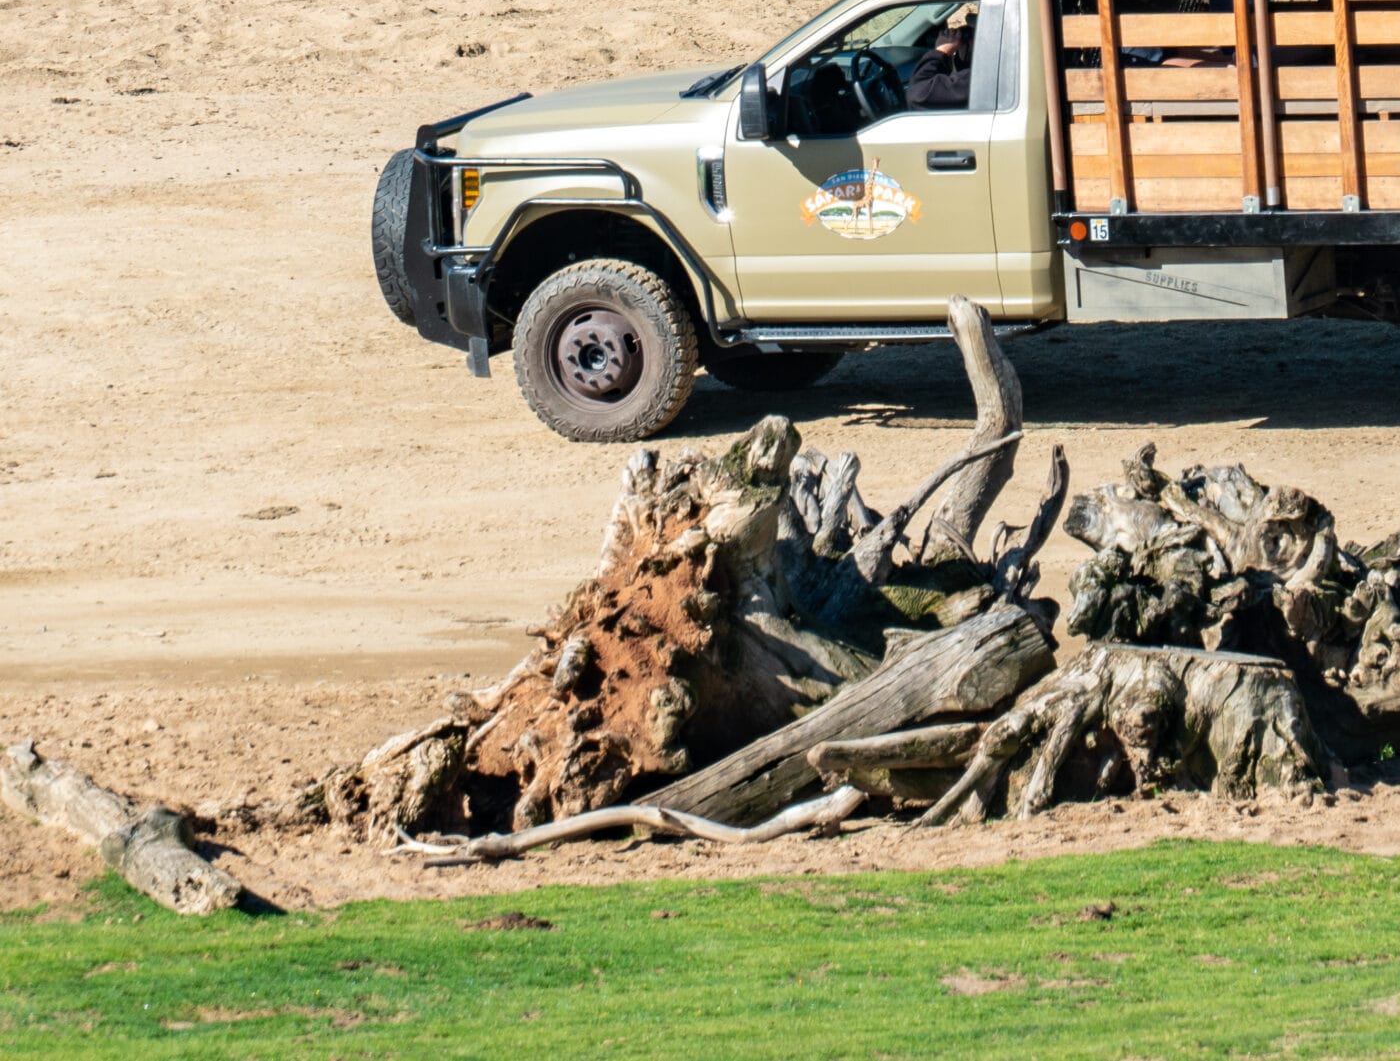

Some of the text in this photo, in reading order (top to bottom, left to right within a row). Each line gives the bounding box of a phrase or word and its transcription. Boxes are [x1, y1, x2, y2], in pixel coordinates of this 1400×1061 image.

[831, 176, 846, 184] SAN
[804, 185, 916, 212] SAFARI PARK
[1093, 224, 1108, 239] 15
[1145, 271, 1198, 293] SUPPLIES
